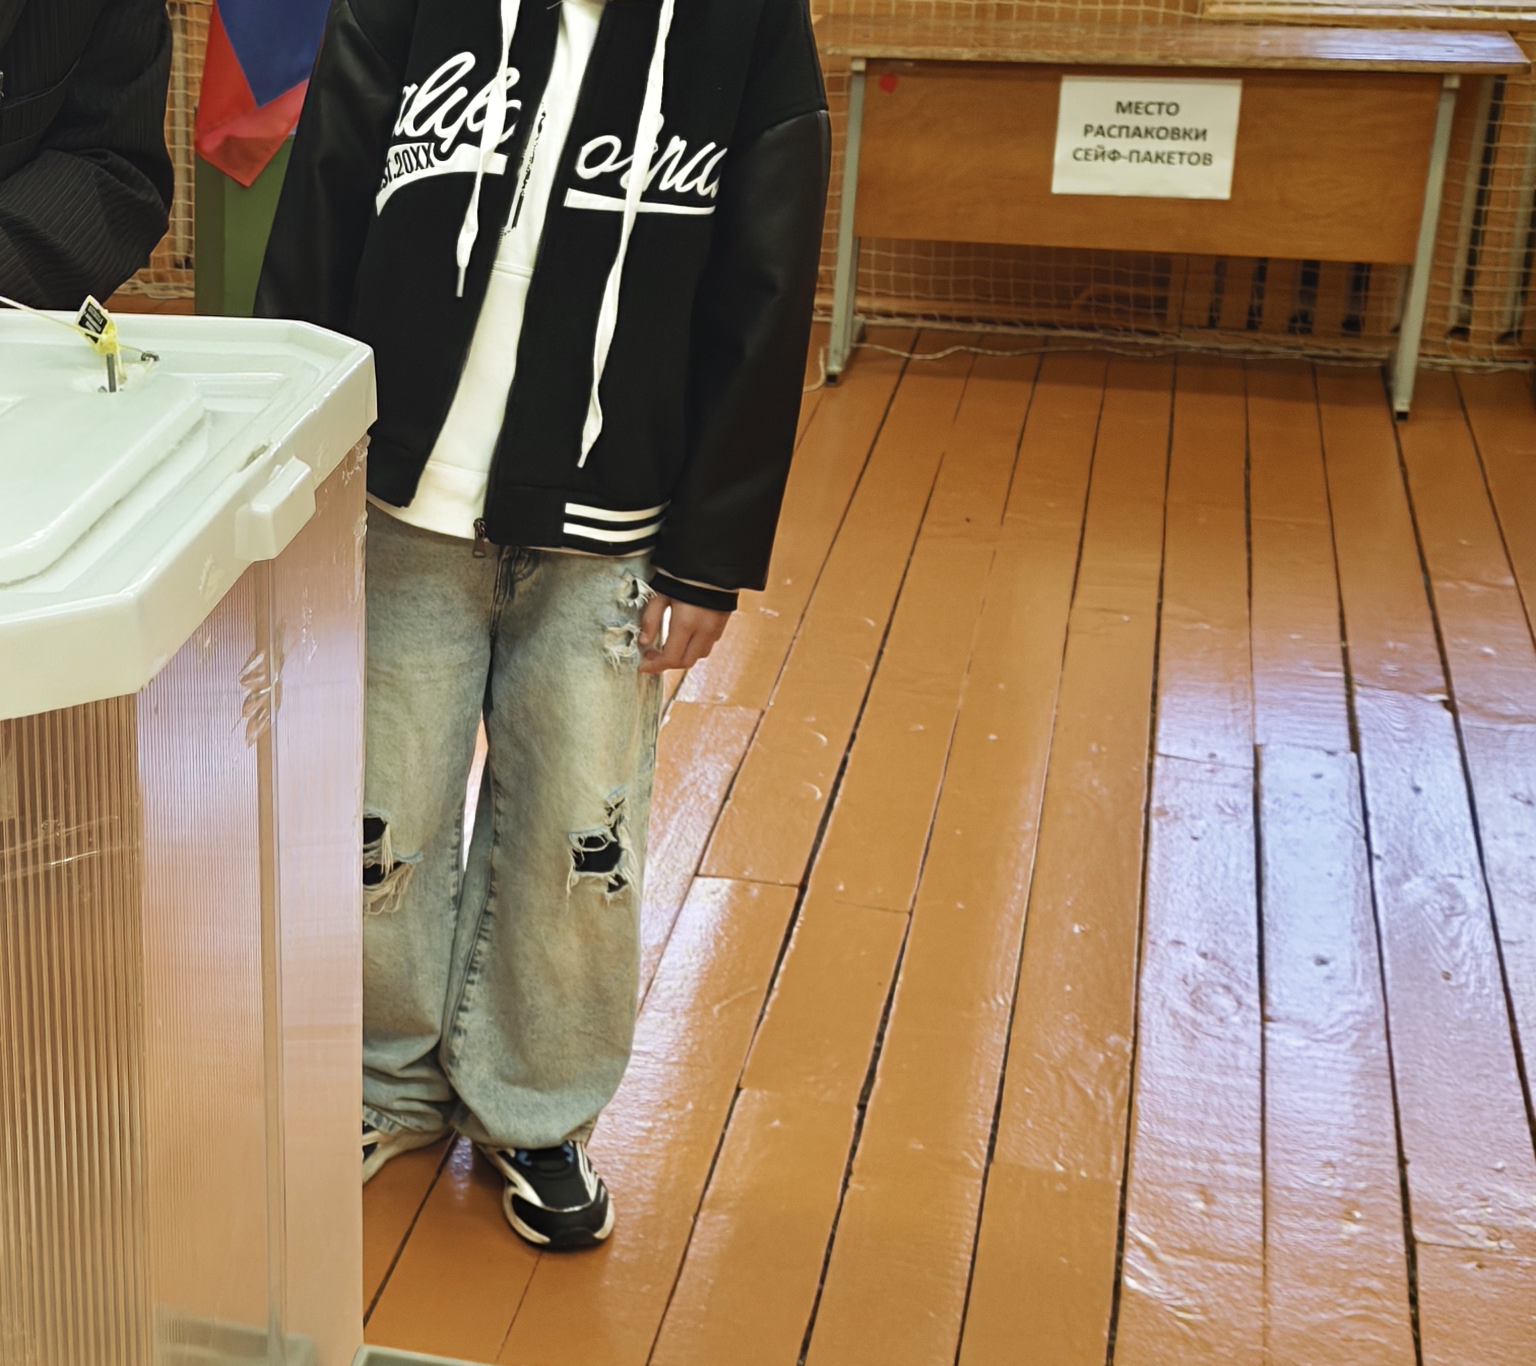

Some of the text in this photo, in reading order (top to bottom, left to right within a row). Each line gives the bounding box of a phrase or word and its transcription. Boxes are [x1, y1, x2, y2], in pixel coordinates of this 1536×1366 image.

[1115, 100, 1180, 117] МЕСТО
[1083, 123, 1208, 142] РАСПАКОВКИ
[1072, 145, 1213, 166] СЕЙФ-ПАКЕТОВ
